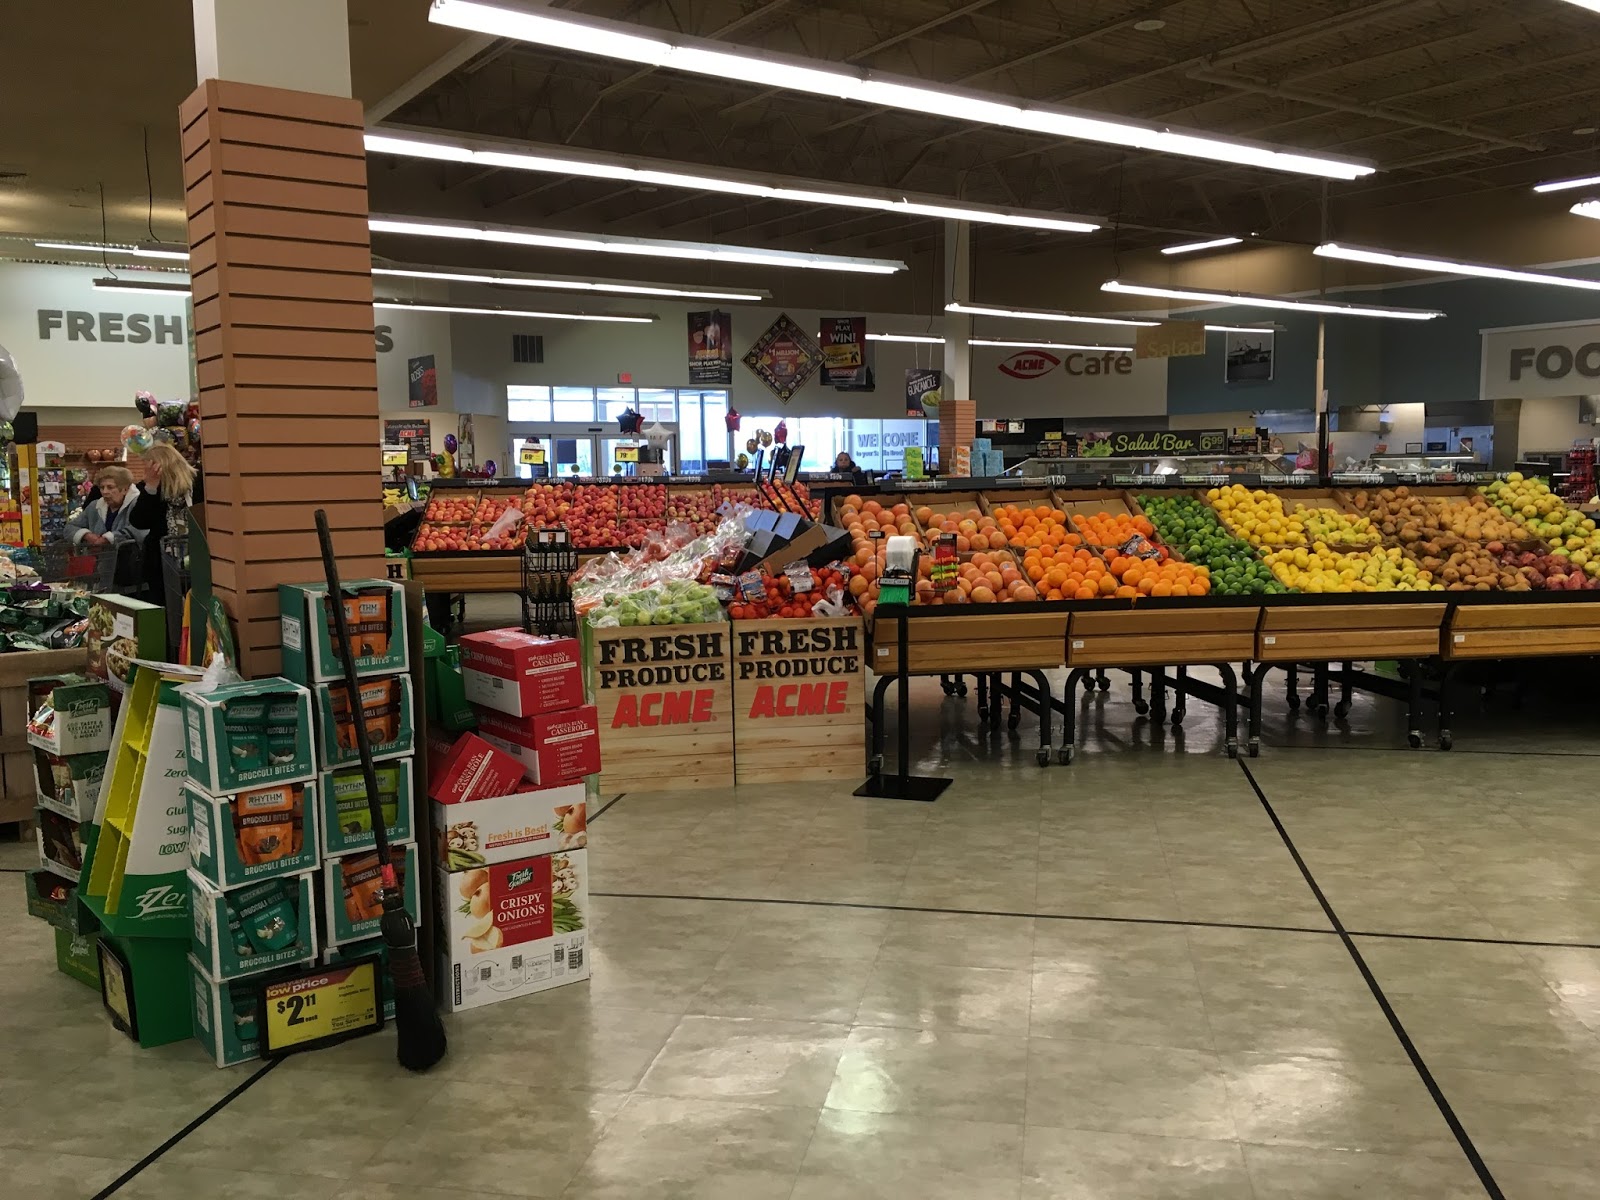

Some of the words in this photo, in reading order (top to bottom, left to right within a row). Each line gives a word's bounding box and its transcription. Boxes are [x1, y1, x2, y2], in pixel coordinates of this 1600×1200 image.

[37, 309, 183, 345] FRESH
[830, 333, 856, 343] WIN!
[1013, 359, 1046, 371] ACME
[1064, 350, 1133, 376] Café
[908, 376, 937, 396] GUACAMOLE
[1115, 432, 1160, 453] Salad
[1161, 433, 1193, 451] Bar
[599, 632, 723, 665] FRESH
[738, 625, 858, 656] FRESH
[532, 655, 570, 668] CASSEROLE
[739, 655, 859, 680] PRODUCE
[600, 661, 724, 689] PRODUCE
[360, 688, 383, 698] HYTHM
[749, 680, 849, 719] ACME
[611, 688, 715, 729] ACME
[551, 723, 588, 736] CASSEROLE
[164, 768, 188, 778] Zero
[238, 767, 273, 781] BROCCOLI
[274, 763, 297, 775] BITES
[458, 752, 485, 792] CASSEROLE
[248, 793, 283, 804] RHYTHM
[242, 815, 272, 825] BROCCOLI
[343, 831, 374, 844] BROCCOLI
[488, 829, 513, 842] Fresh
[515, 828, 523, 837] is
[524, 823, 548, 837] Best!
[159, 842, 187, 855] LOW
[244, 862, 279, 876] BROCCOLI
[280, 856, 301, 868] BITES
[239, 899, 268, 918] BROCCOLI
[500, 892, 542, 911] CRISPY
[497, 903, 545, 923] ONIONS
[352, 919, 381, 932] BROCCOL
[239, 954, 274, 969] BROCCOLI
[276, 948, 297, 960] BITES
[266, 986, 291, 998] low
[292, 977, 329, 994] price
